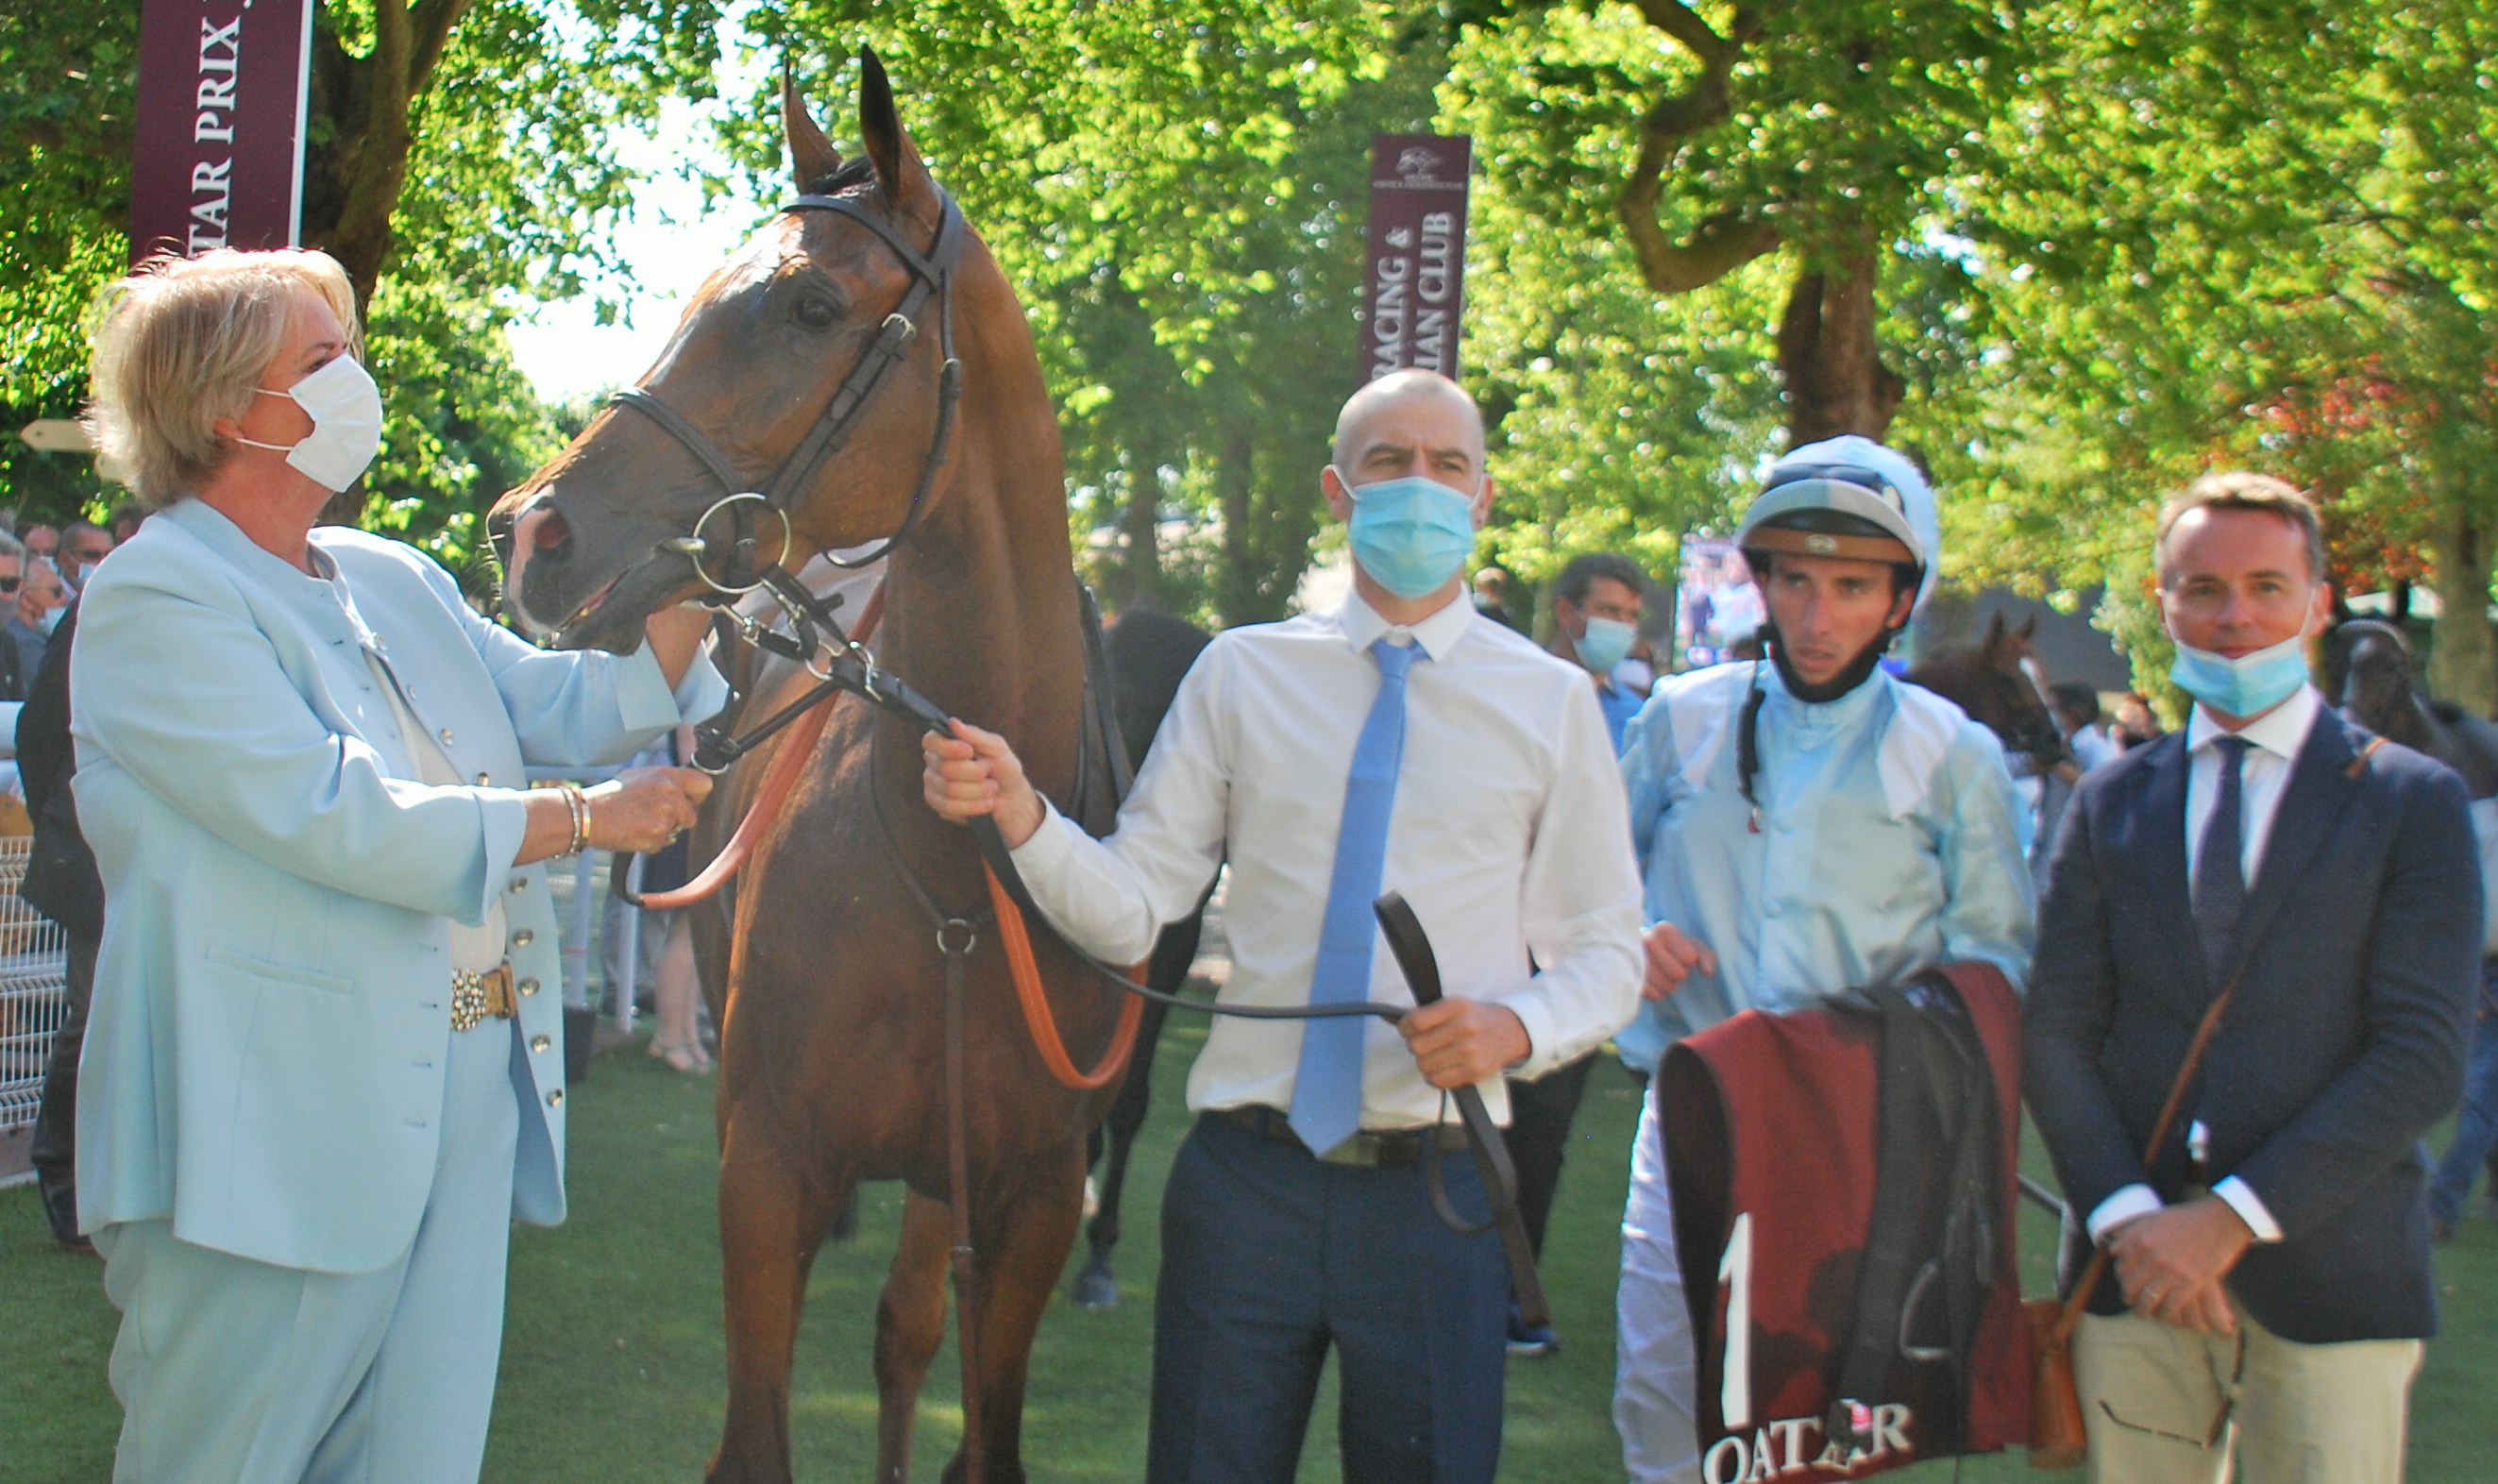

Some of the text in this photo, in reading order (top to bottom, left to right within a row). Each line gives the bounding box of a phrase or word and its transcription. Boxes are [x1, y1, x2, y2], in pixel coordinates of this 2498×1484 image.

[194, 15, 241, 144] PRIX
[1385, 226, 1412, 248] &
[1418, 211, 1456, 303] CLUB
[1717, 1211, 1752, 1430] 1
